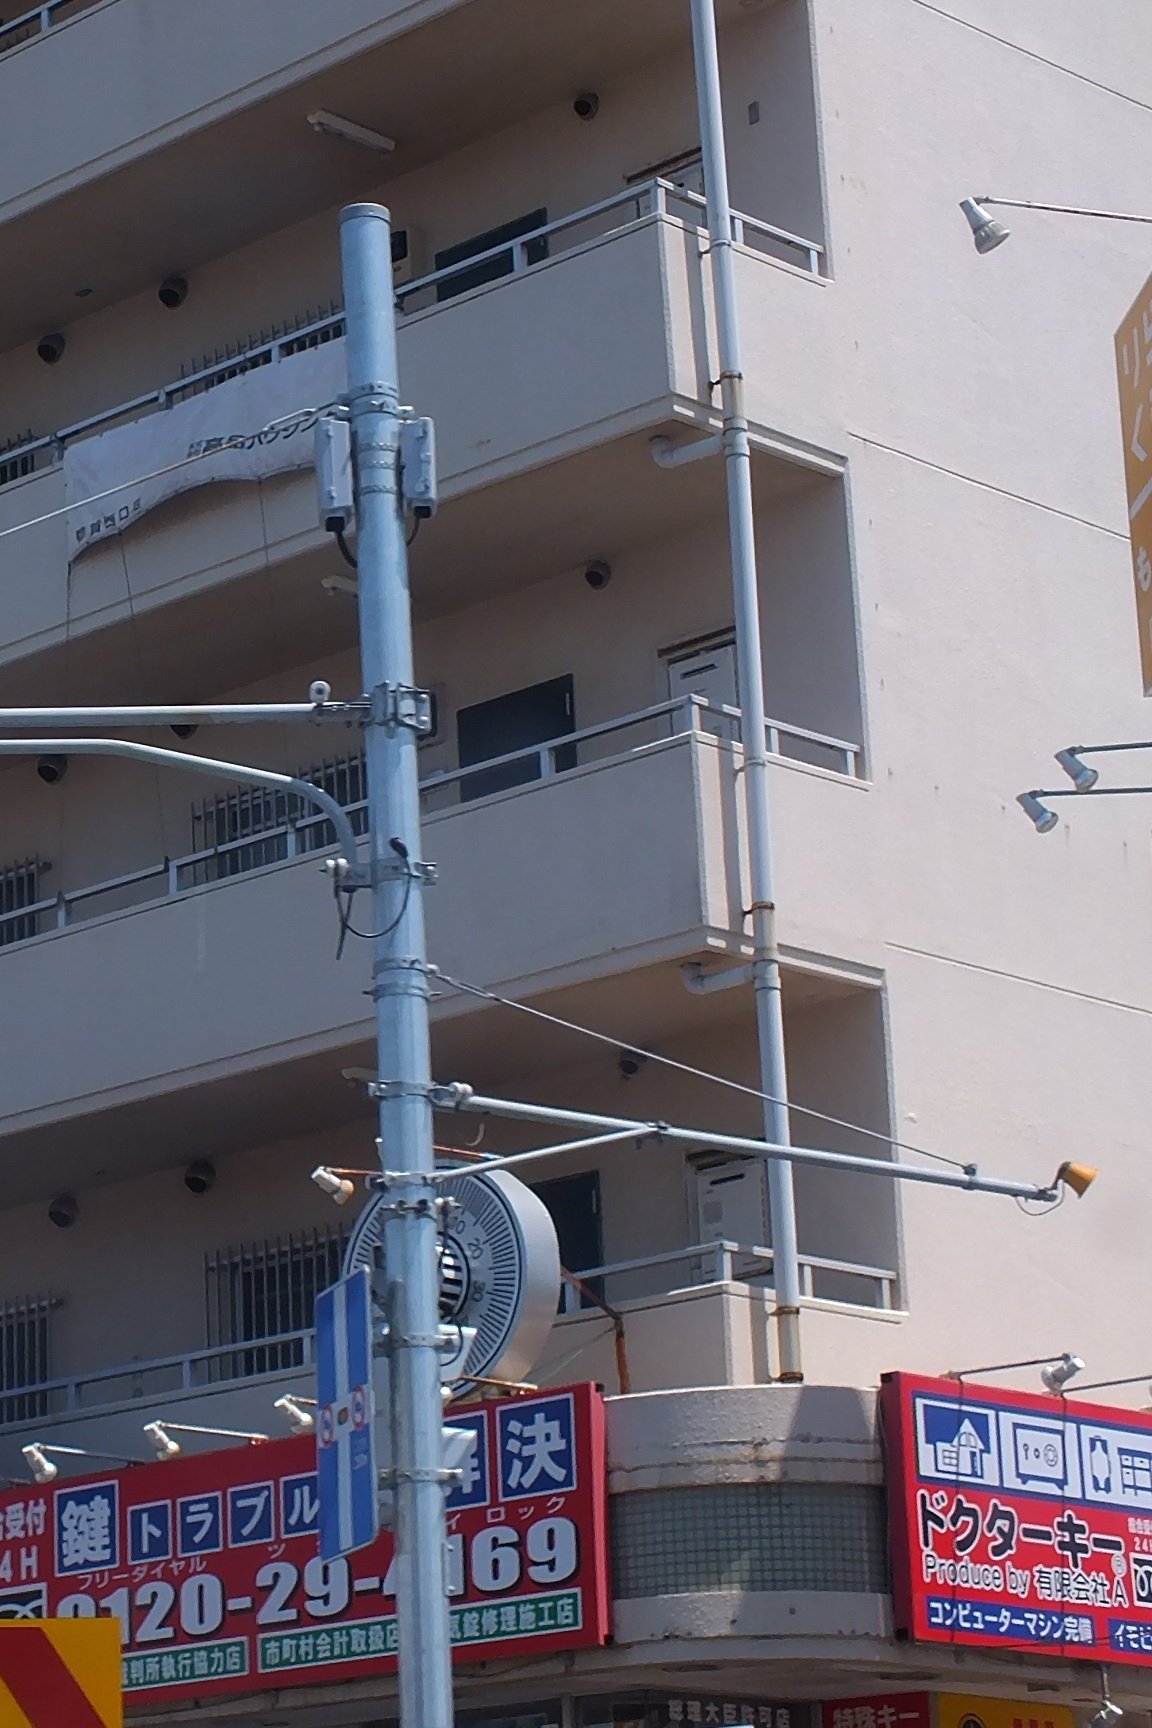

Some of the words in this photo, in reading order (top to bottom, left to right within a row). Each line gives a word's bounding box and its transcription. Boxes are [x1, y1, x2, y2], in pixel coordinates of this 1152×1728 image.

[917, 1489, 1125, 1571] ドクターキー
[77, 1557, 208, 1591] フリーダイヤル
[923, 1553, 1003, 1592] Produce
[1006, 1563, 1030, 1596] by
